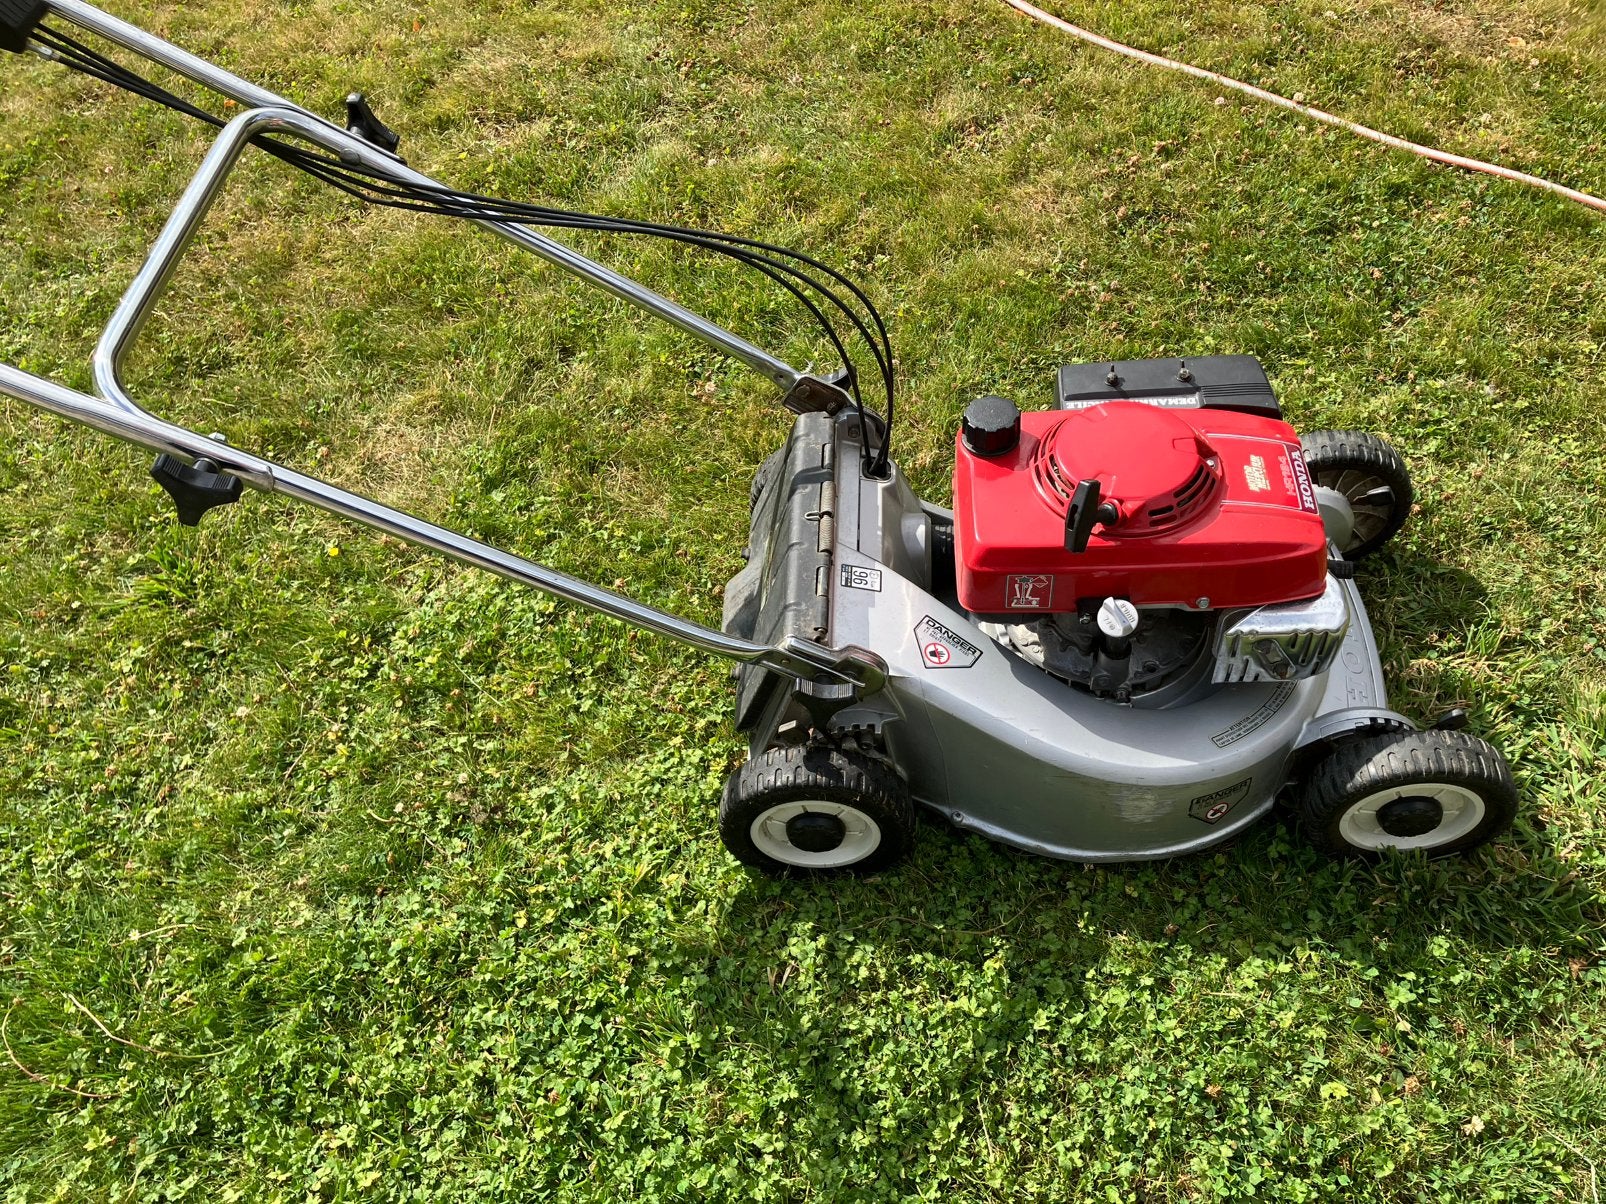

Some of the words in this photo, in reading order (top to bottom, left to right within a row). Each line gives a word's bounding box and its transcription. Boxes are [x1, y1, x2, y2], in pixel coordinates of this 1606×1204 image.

[1291, 450, 1315, 510] HONDA
[853, 571, 868, 586] 96
[926, 619, 978, 655] DANGER
